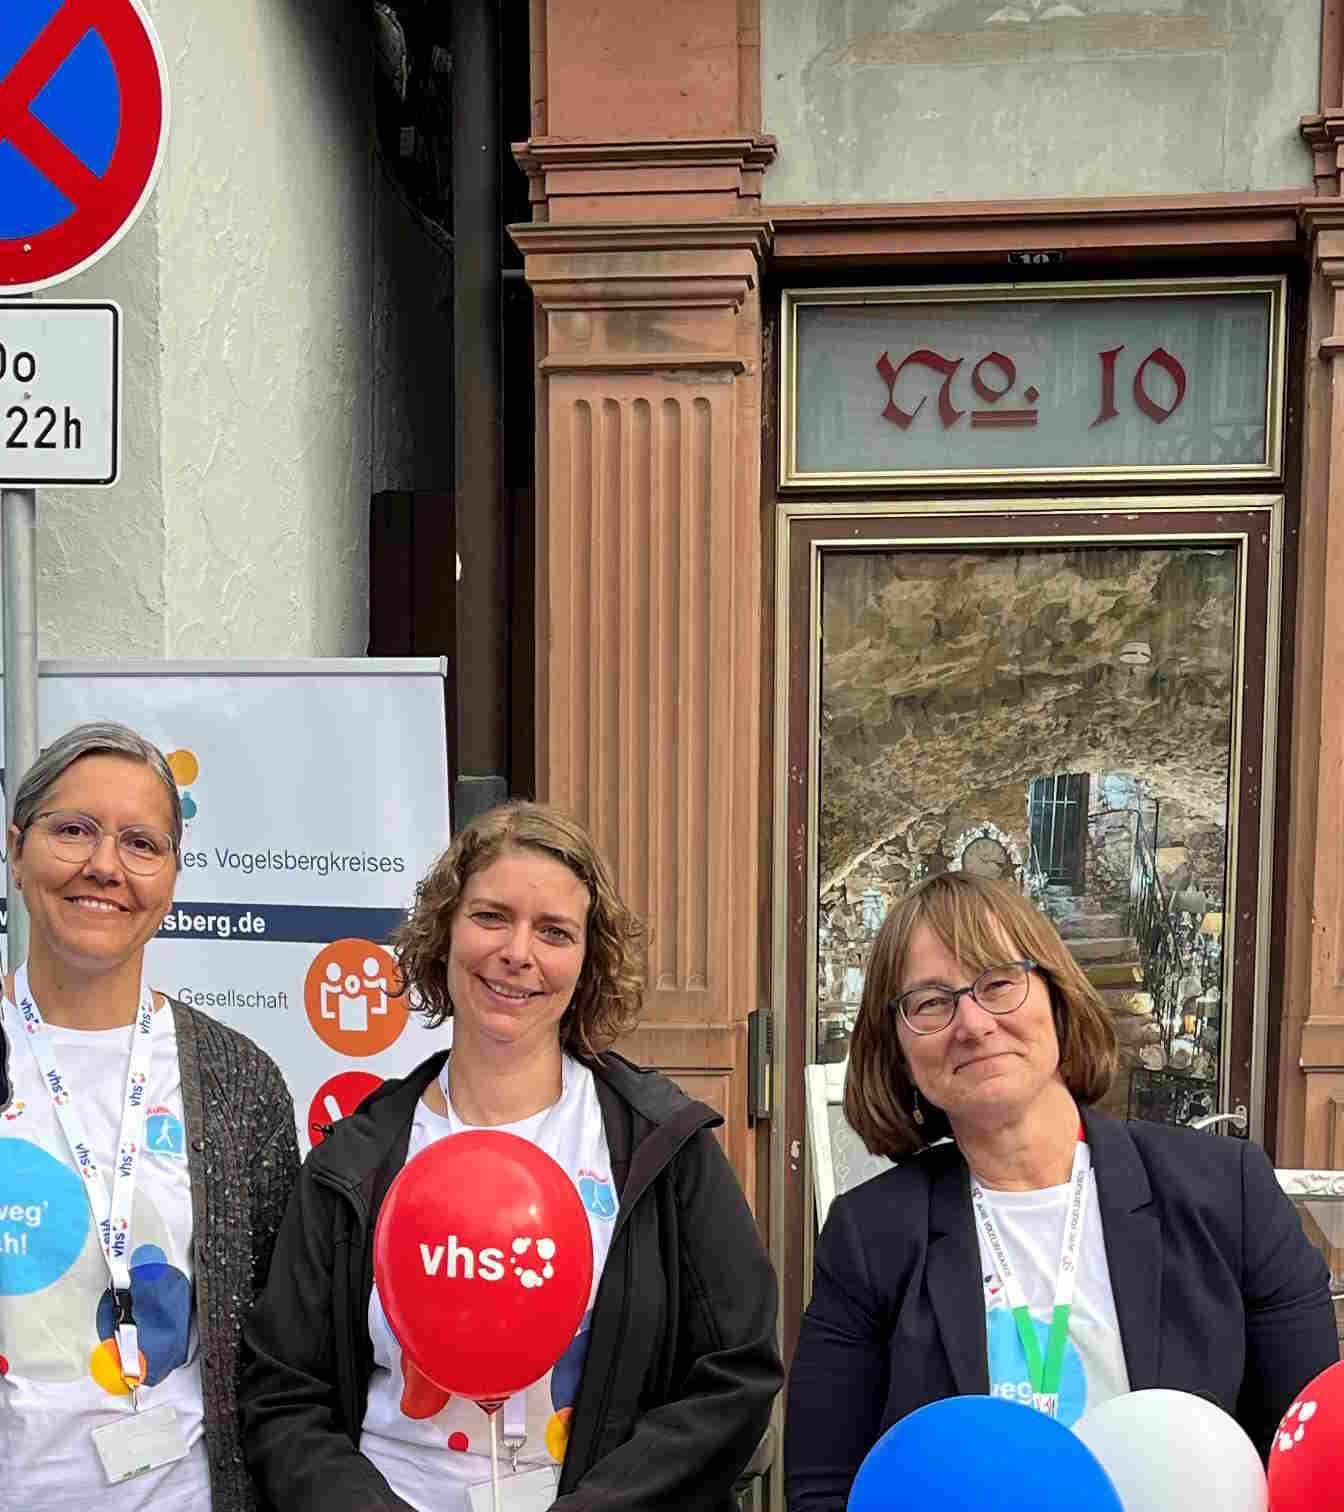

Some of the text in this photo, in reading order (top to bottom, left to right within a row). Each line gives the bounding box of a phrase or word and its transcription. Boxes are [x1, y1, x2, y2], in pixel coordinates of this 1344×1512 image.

[1087, 345, 1186, 424] 10
[184, 849, 405, 875] es Vogelsbergkreises
[177, 987, 289, 1010] Gesellschaft
[130, 1083, 143, 1108] vhs
[120, 1152, 133, 1178] vhs
[112, 1230, 126, 1258] vhs
[419, 1235, 505, 1281] vhs
